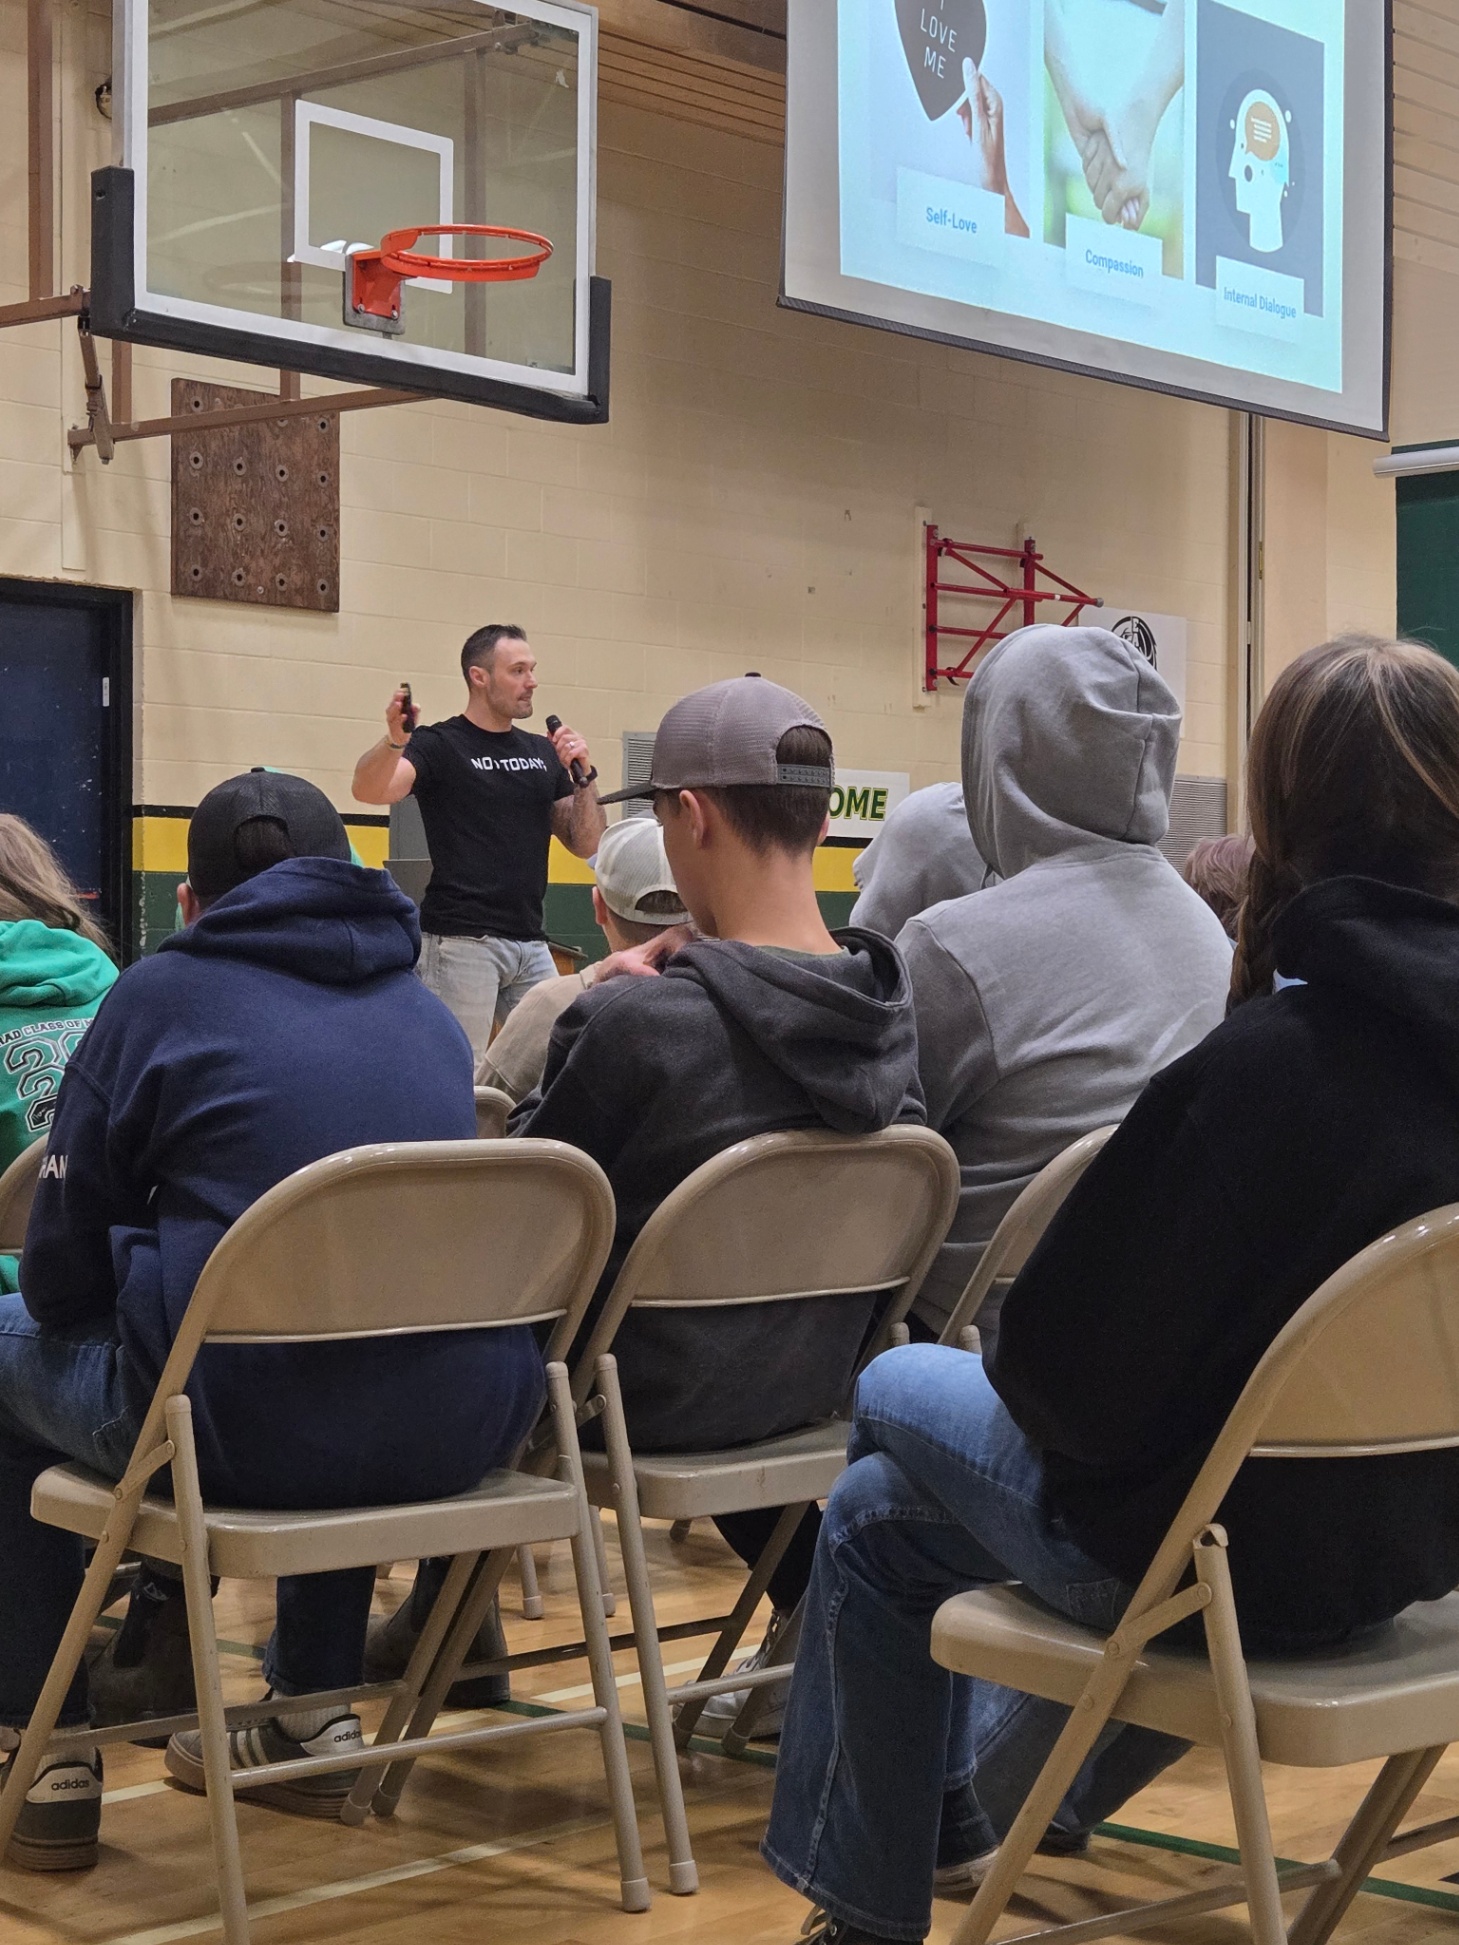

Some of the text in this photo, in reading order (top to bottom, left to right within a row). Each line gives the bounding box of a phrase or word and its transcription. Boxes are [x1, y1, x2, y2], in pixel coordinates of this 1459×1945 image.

[920, 8, 957, 52] LOVE
[924, 46, 946, 78] ME
[926, 207, 978, 234] Self-Love
[1085, 249, 1144, 278] Compassion
[1223, 286, 1297, 319] Internal Dialogue
[22, 1020, 64, 1036] CLASS
[64, 1019, 82, 1029] OF
[51, 1778, 90, 1791] adidas
